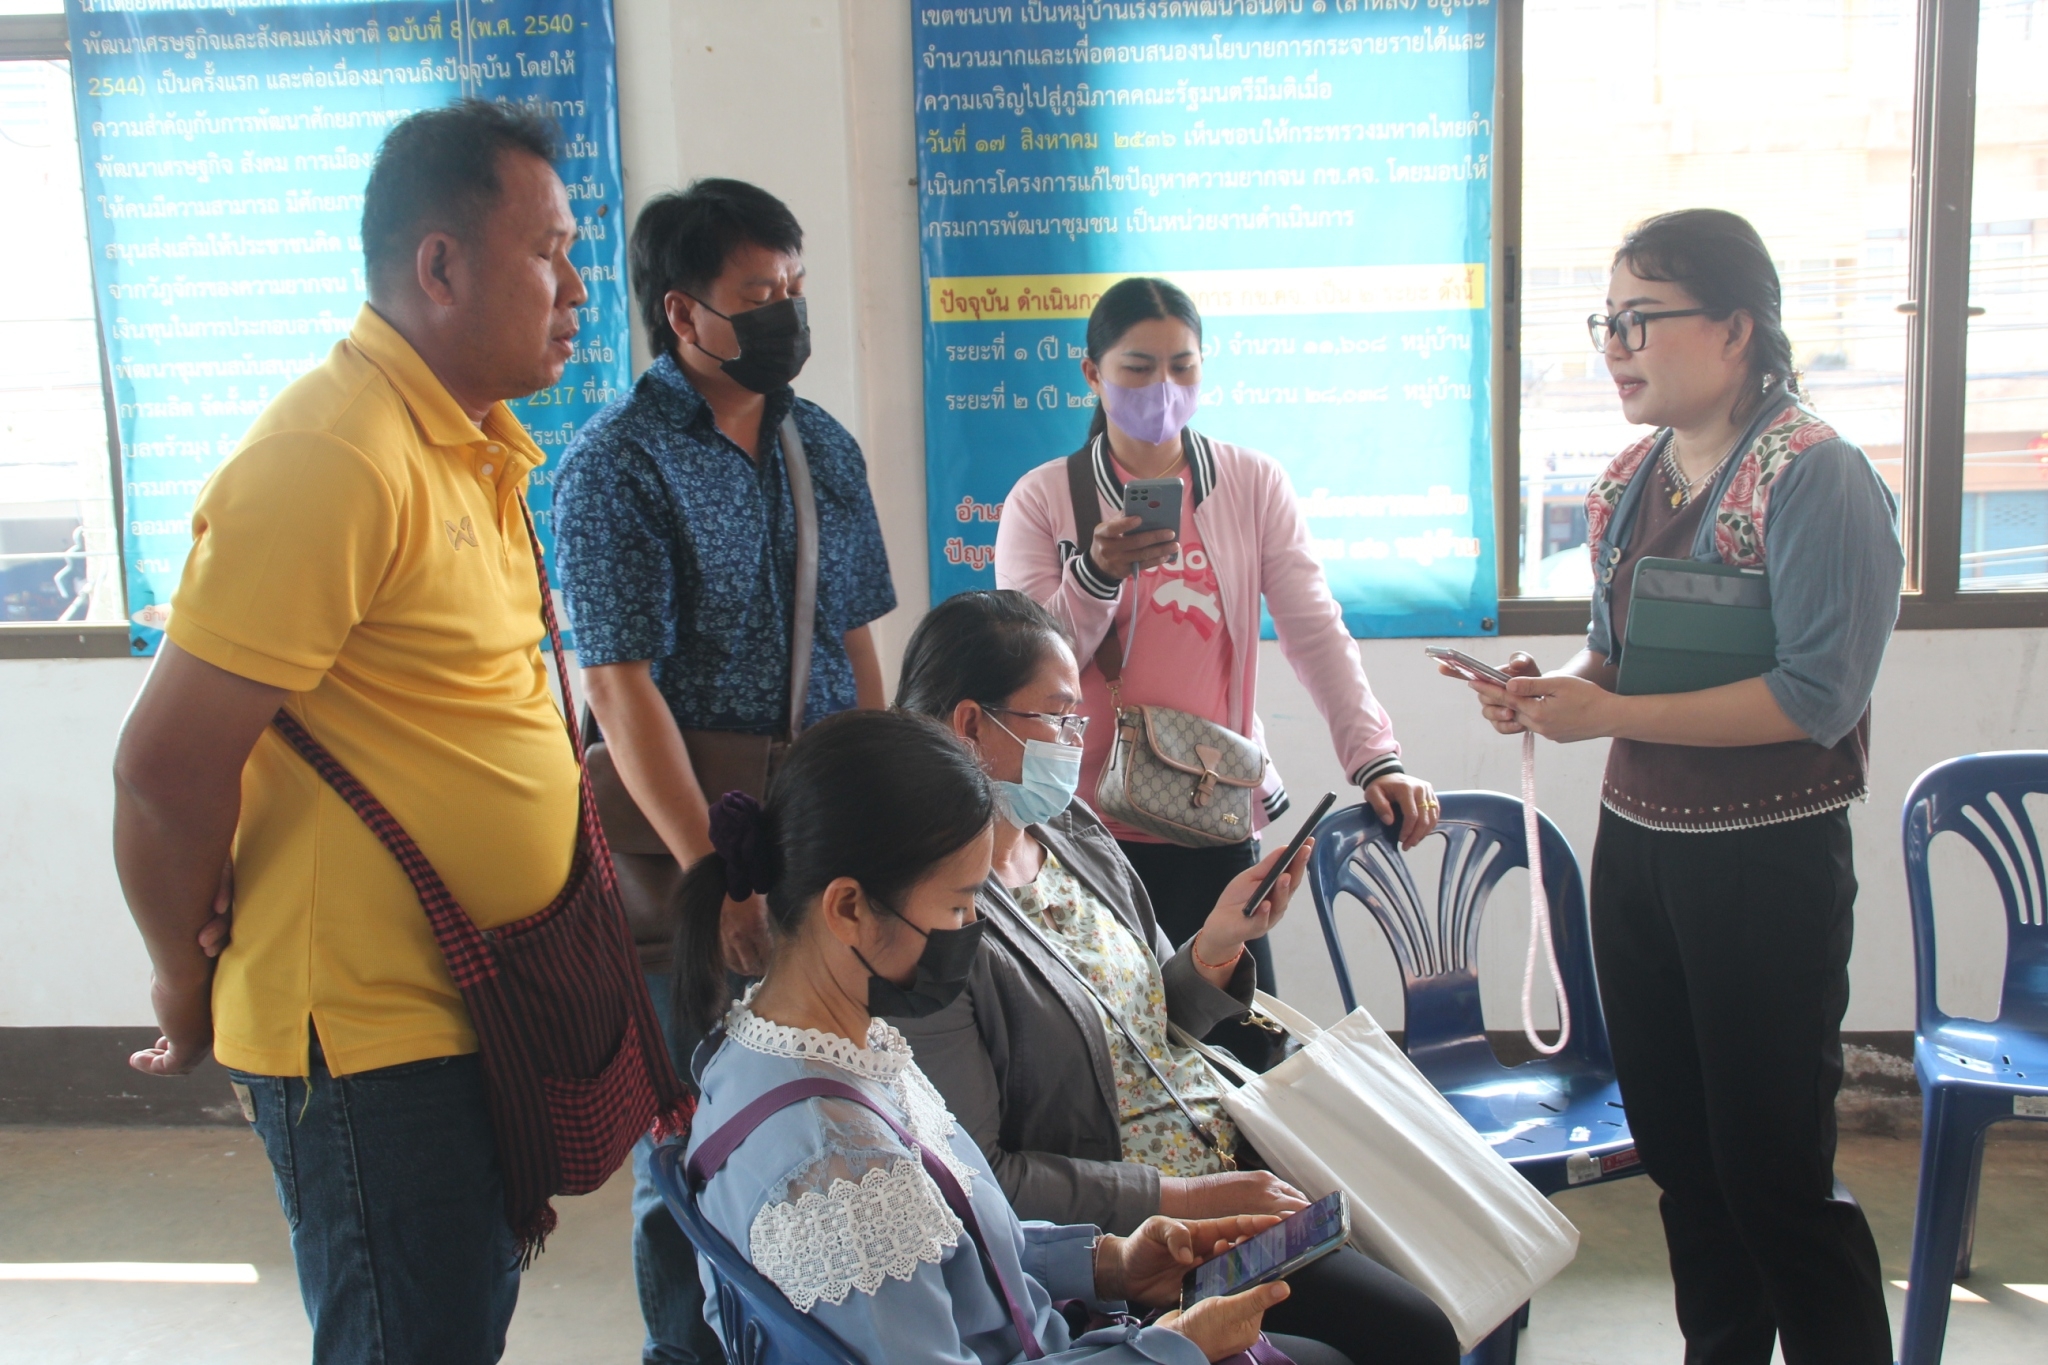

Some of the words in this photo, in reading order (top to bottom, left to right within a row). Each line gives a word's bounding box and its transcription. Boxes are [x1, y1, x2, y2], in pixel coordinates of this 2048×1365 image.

[387, 10, 442, 42] ฉบับที่
[450, 20, 461, 39] 8
[470, 17, 516, 39] (พ.ศ.
[524, 13, 573, 36] 2540
[921, 6, 1012, 26] เขตชนบท
[88, 76, 146, 97] 2544)
[157, 61, 259, 94] เป็นครั้งแรก
[516, 50, 575, 77] โดยให้
[242, 149, 288, 174] สังคม
[565, 133, 598, 158] เน้น
[926, 124, 967, 153] วันที่
[975, 134, 1006, 153] ๑๗
[1021, 127, 1098, 151] สิงหาคม
[1113, 129, 1177, 149] ๒๕๓๖
[1386, 153, 1488, 184] โดยมอบให้
[929, 211, 1118, 242] กรมการพัฒนาชุมชน
[1126, 203, 1355, 234] เป็นหน่วยงานดำเนินการ
[578, 265, 617, 282] คลน
[940, 287, 1010, 320] ปัจจุบัน
[1017, 286, 1102, 312] ดำเนินกา
[567, 335, 613, 364] ย์เพื่อ
[945, 331, 1005, 361] ระยะที่
[1014, 348, 1028, 360] ๑
[1037, 335, 1059, 361] (ปี
[1229, 331, 1295, 356] จำนวน
[1401, 325, 1471, 359] หมู่บ้าน
[528, 386, 575, 406] 2517
[945, 380, 1005, 410] ระยะที่
[1013, 393, 1028, 409] ๒
[1036, 384, 1058, 411] (ปี
[1231, 380, 1298, 405] จำนวน
[1402, 375, 1472, 409] หมู่บ้าน
[134, 557, 171, 574] งาน
